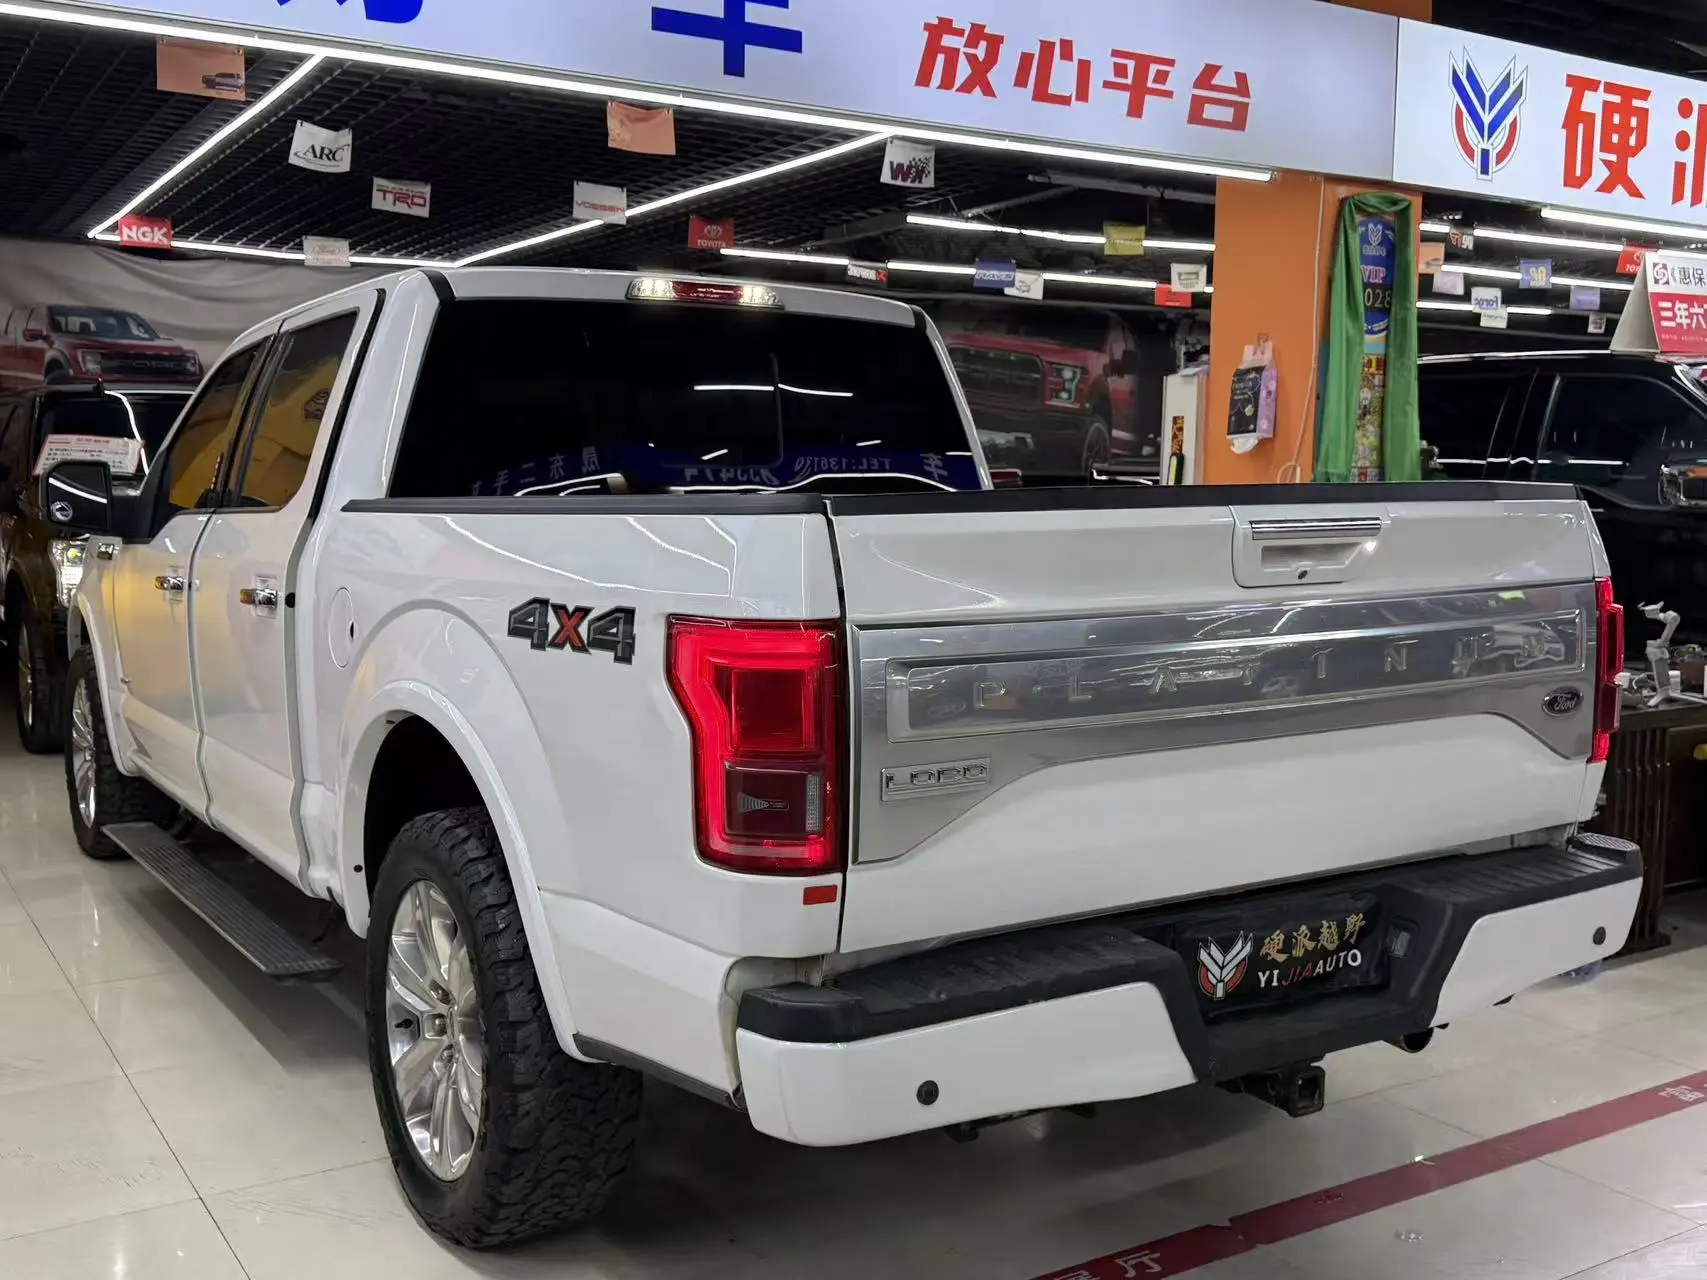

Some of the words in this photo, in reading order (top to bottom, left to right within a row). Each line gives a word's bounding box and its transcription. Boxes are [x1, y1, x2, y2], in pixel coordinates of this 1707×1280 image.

[914, 16, 1251, 132] 放心平台
[303, 143, 345, 162] ARC
[376, 188, 427, 209] TRD
[575, 200, 626, 213] VOSSEN
[121, 225, 168, 244] NGK
[697, 239, 728, 249] TOYOTA
[1360, 264, 1387, 283] VIP
[1658, 300, 1707, 329] 三年六
[1258, 912, 1367, 964] 硬派越野
